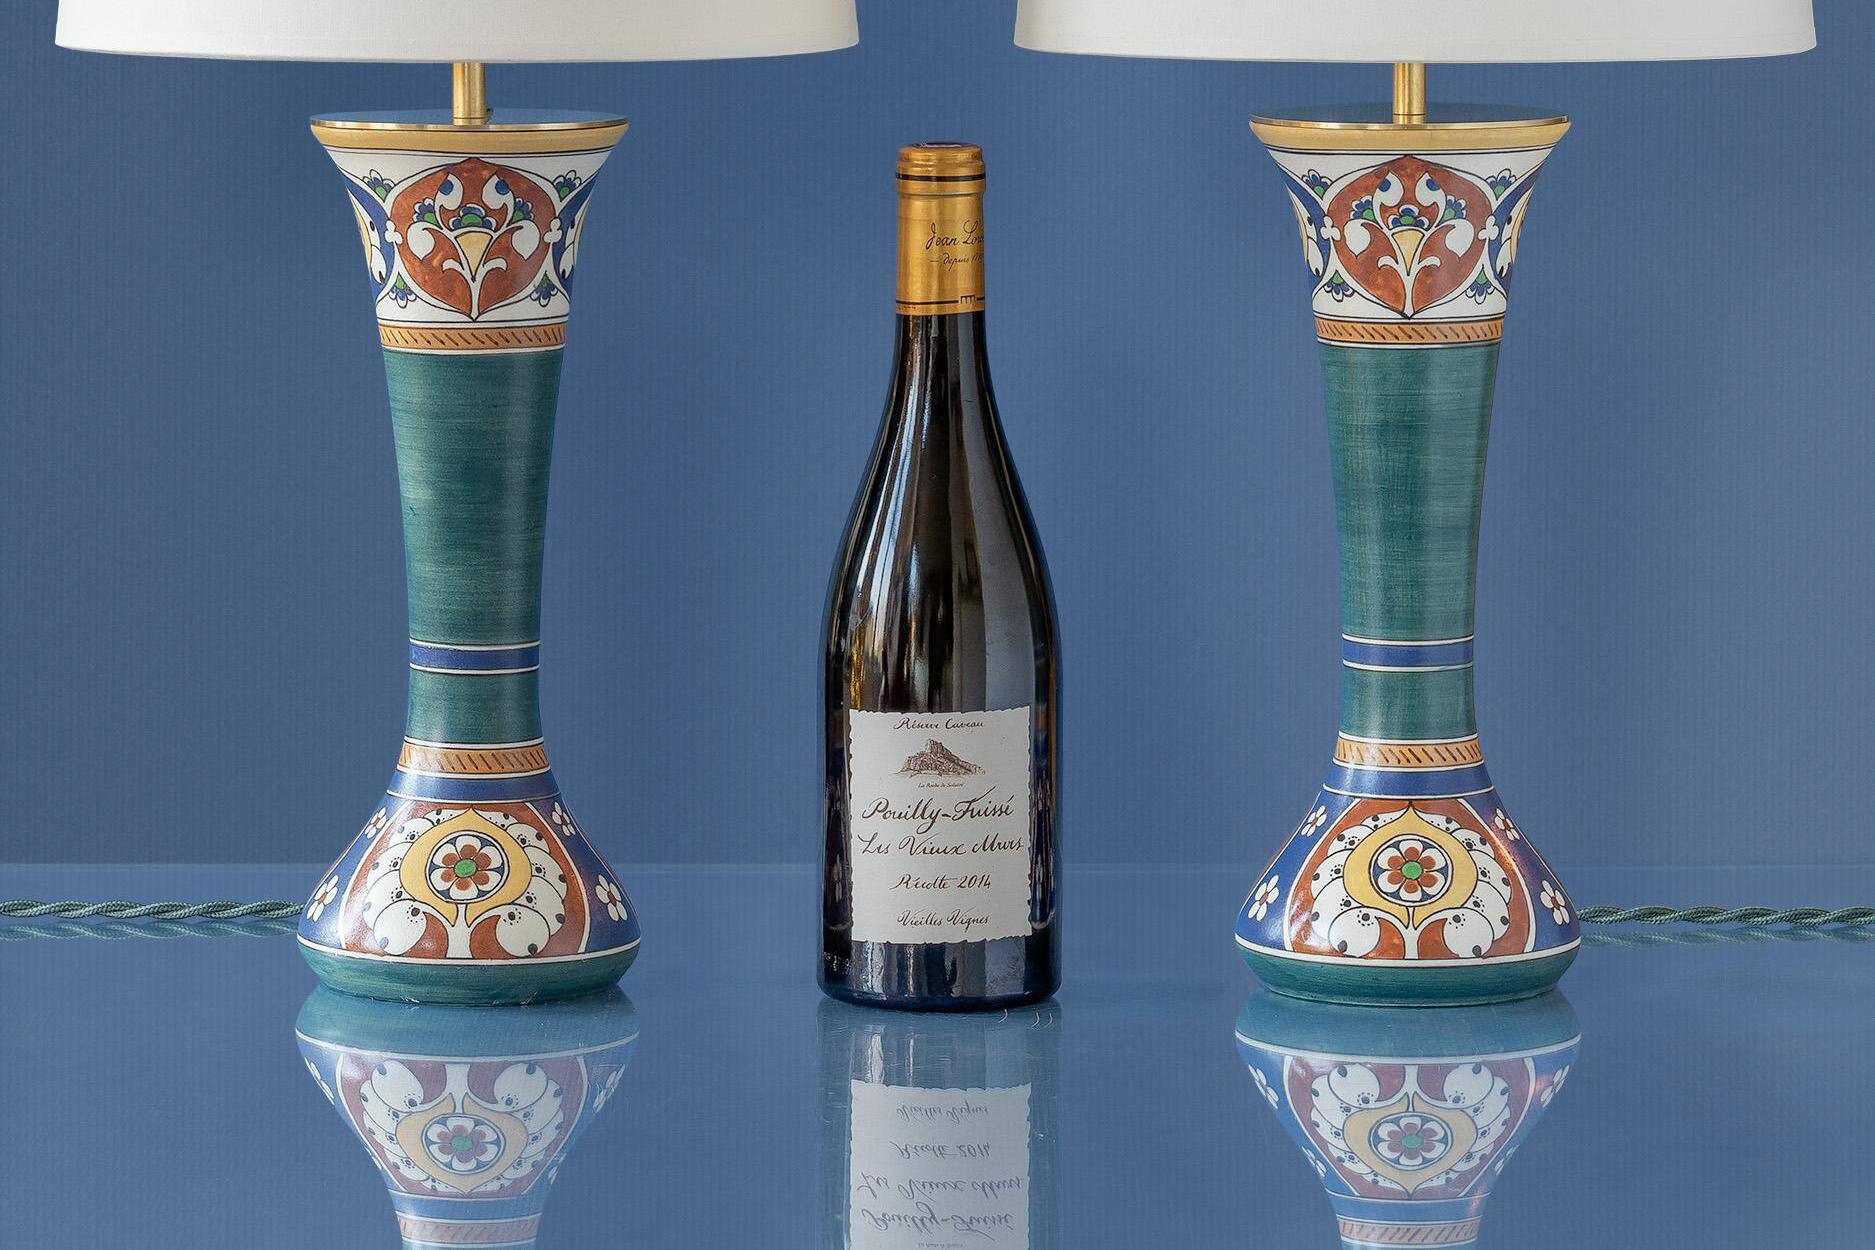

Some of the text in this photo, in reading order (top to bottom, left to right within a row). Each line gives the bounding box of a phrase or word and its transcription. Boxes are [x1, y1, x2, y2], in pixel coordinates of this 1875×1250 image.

[925, 222, 959, 250] Jean
[945, 717, 984, 730] Caveau
[862, 786, 1015, 835] Pouilly-Fuissé
[857, 832, 1024, 856] Les Vieux Murs
[889, 873, 992, 890] Récolte 2014
[896, 907, 989, 933] Vieilles Vignes
